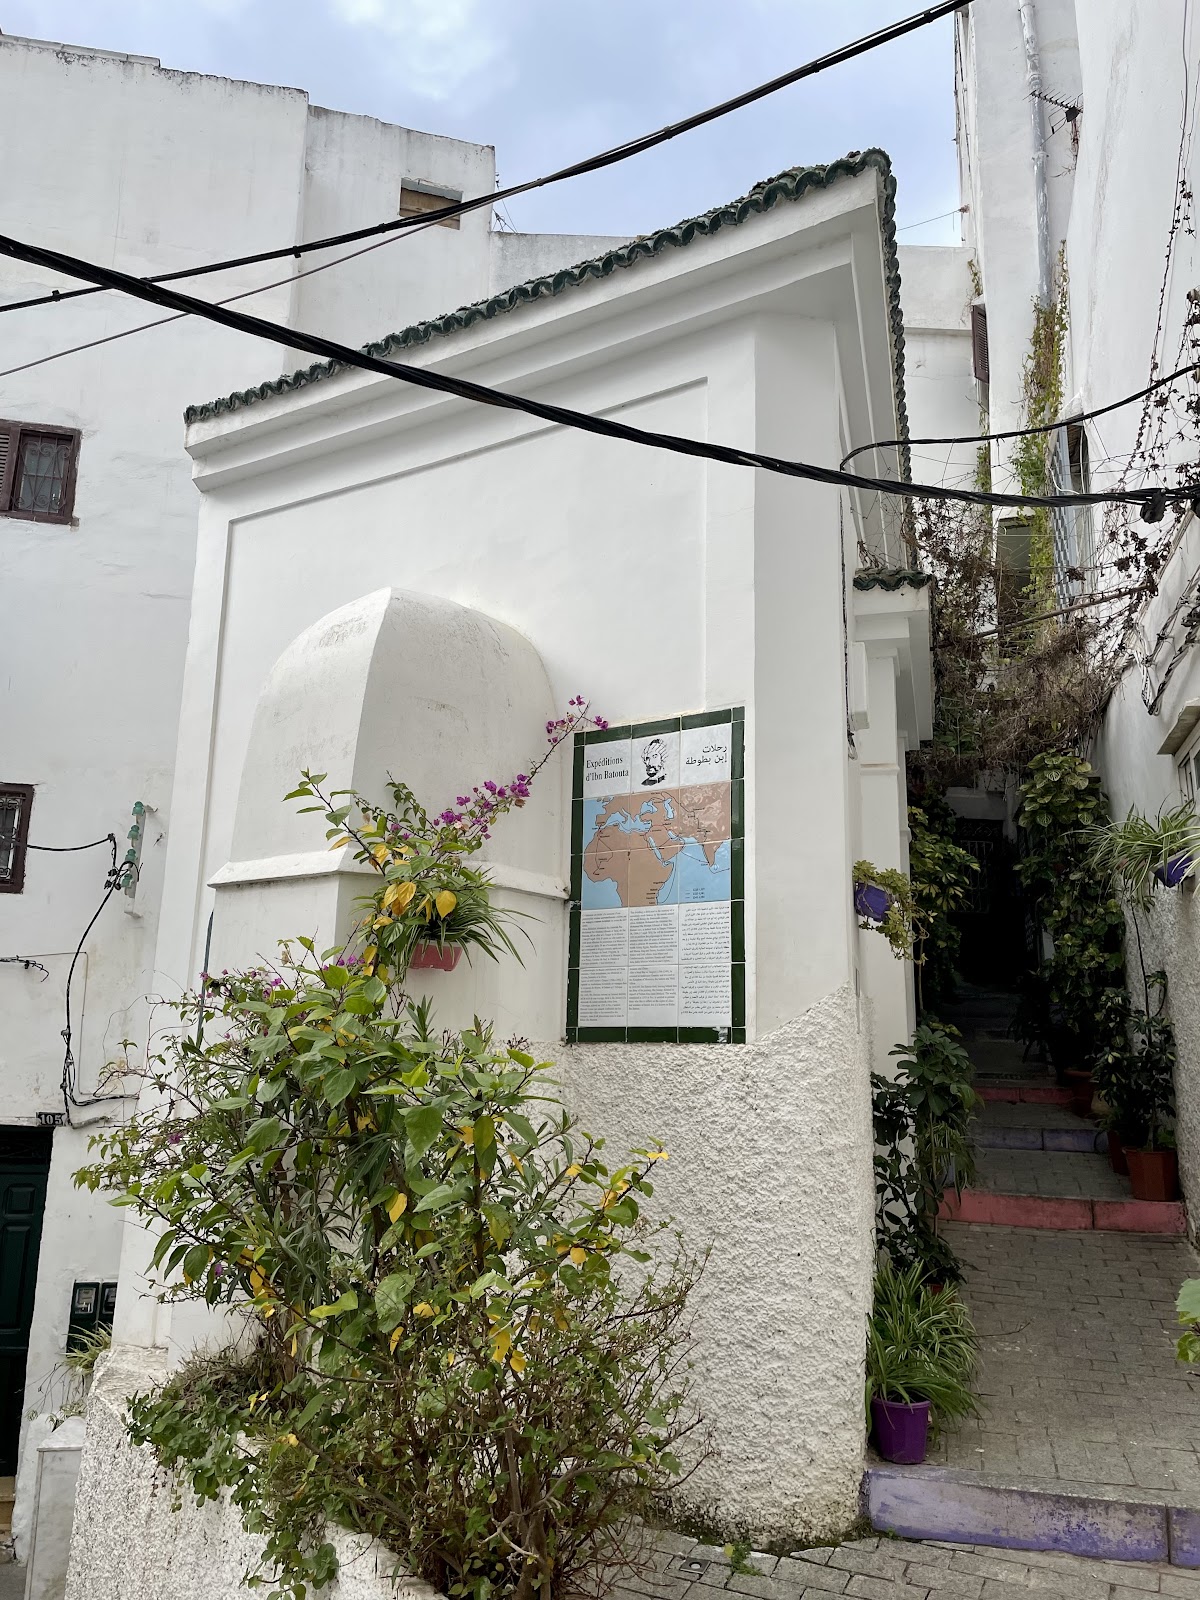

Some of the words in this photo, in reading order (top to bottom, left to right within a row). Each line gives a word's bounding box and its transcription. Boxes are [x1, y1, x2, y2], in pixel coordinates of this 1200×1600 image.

[702, 744, 727, 753] رحلات
[586, 757, 623, 769] Expéditions
[685, 757, 712, 767] بطوطة
[585, 772, 603, 782] d'Ibn
[604, 769, 629, 779] Batouta
[40, 1114, 62, 1125] 105
